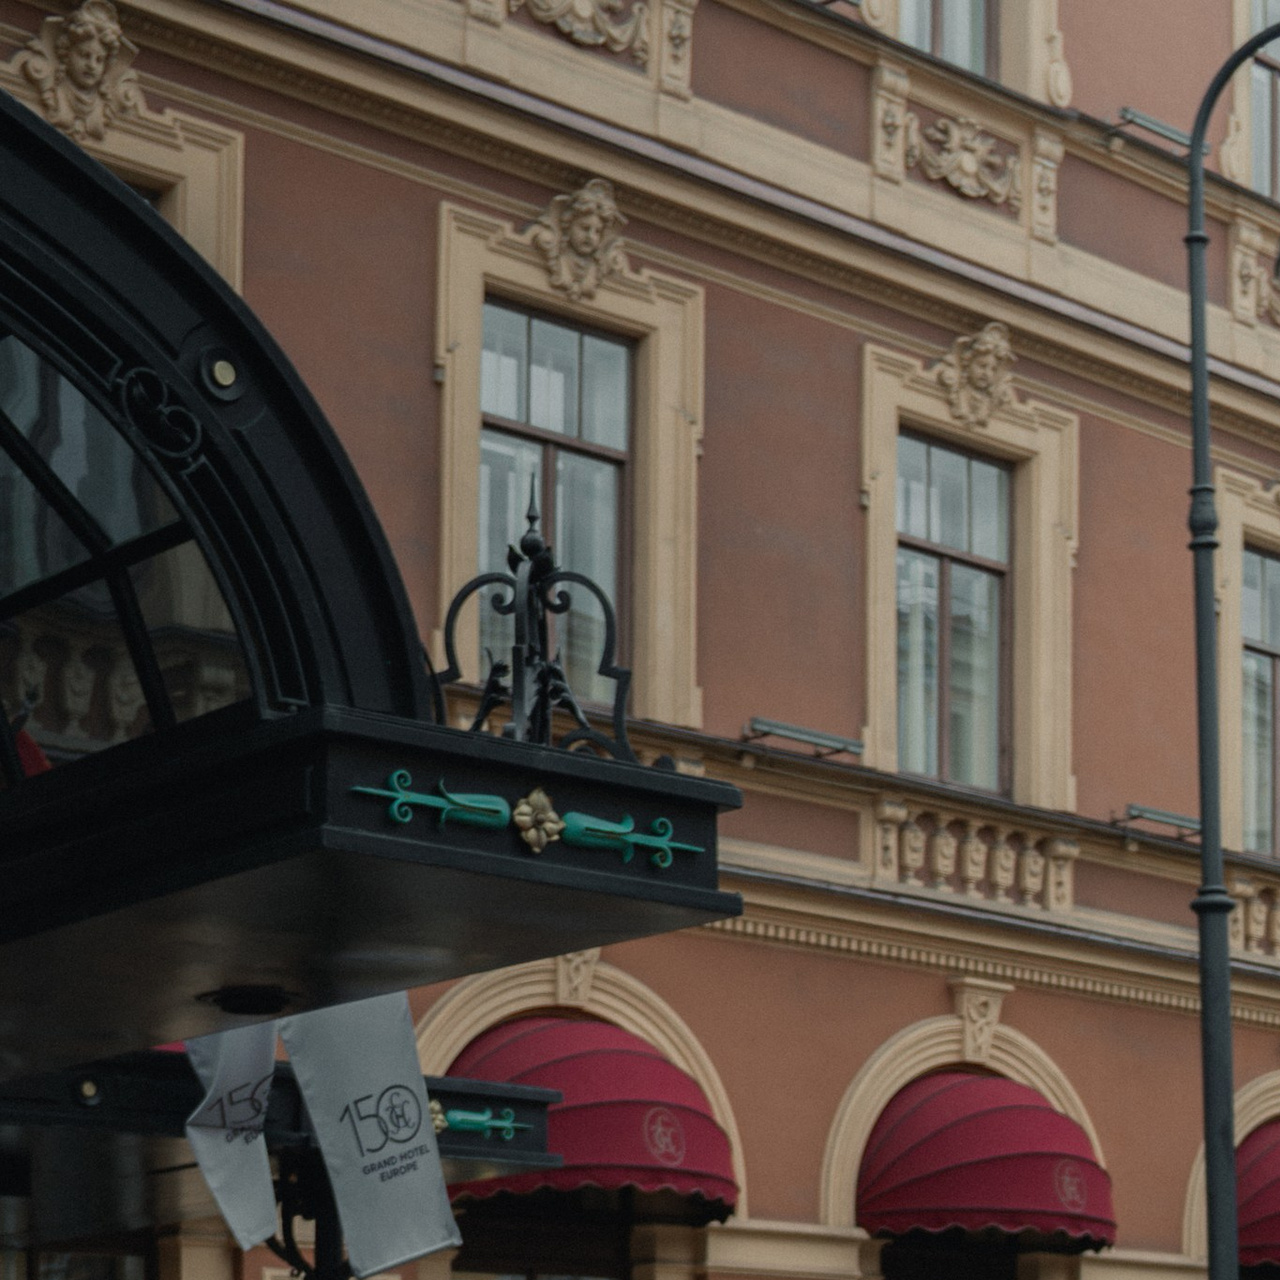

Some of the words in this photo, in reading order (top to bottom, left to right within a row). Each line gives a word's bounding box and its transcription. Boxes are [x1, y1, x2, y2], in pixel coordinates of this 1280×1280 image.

[362, 1155, 398, 1176] GRAND
[399, 1144, 431, 1162] HOTEL
[380, 1160, 419, 1183] EUROPE
